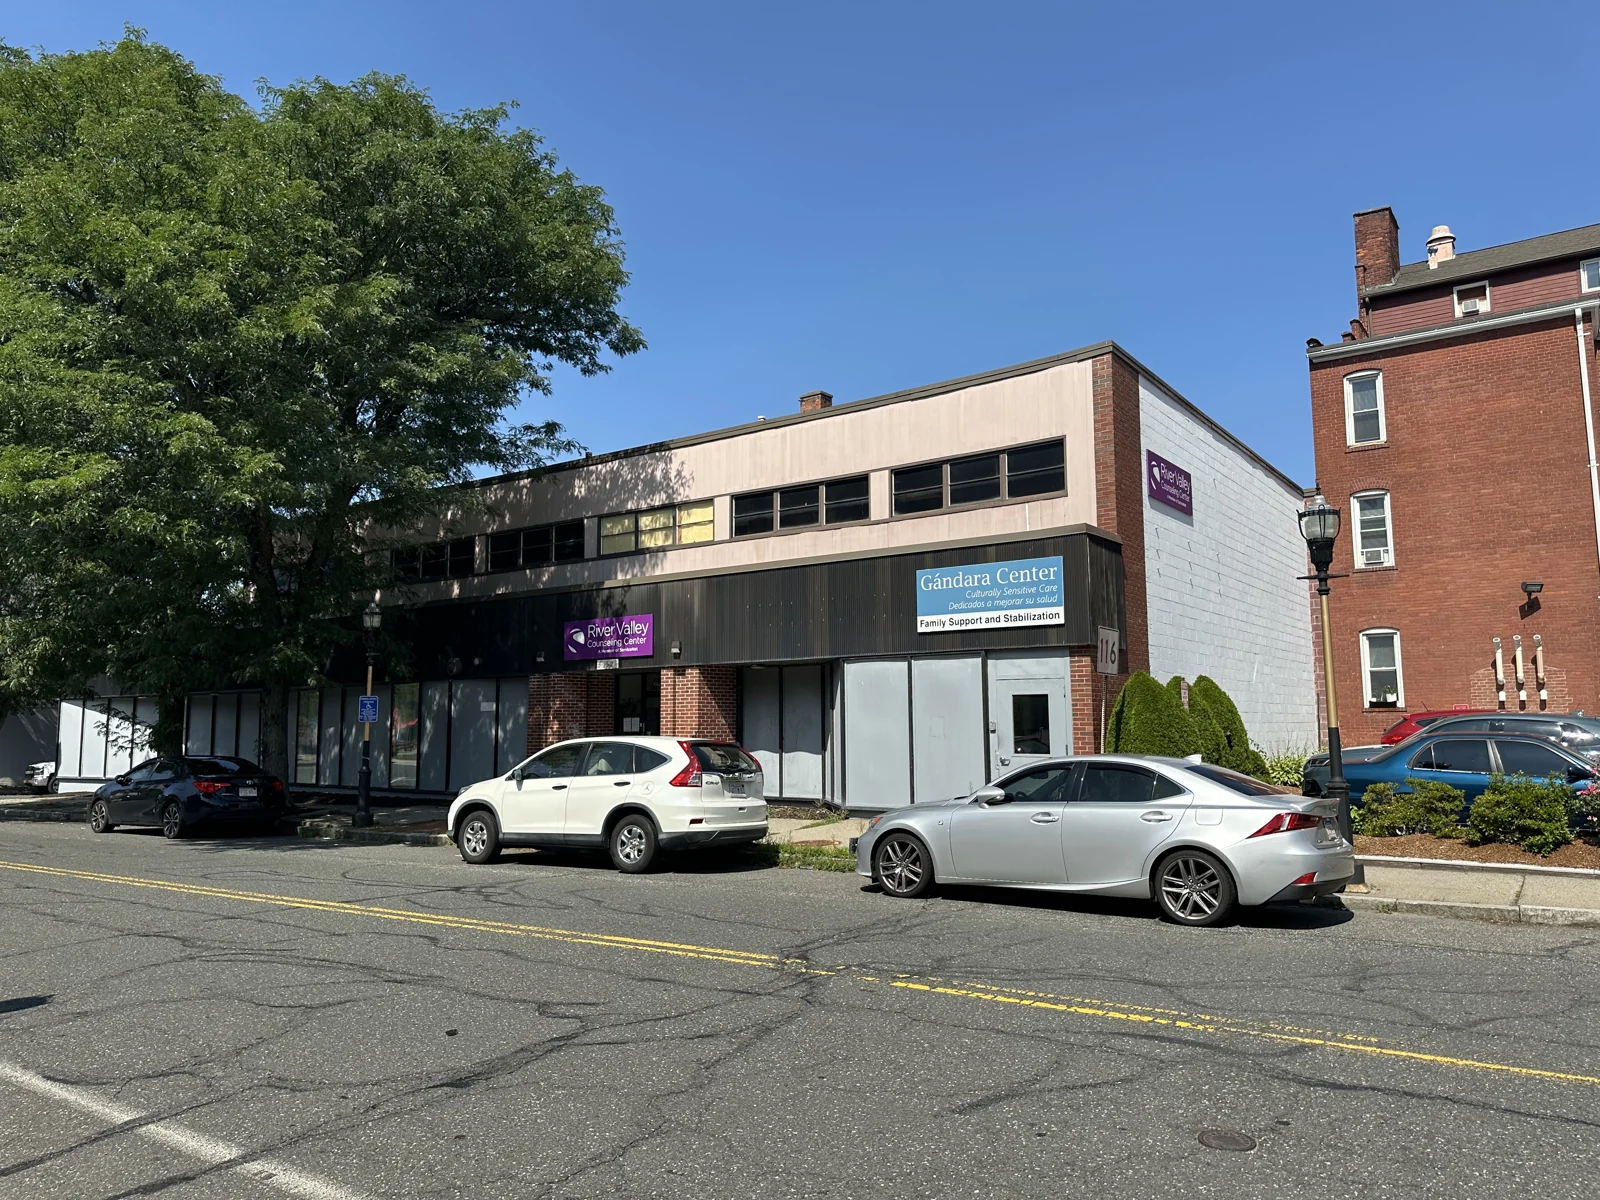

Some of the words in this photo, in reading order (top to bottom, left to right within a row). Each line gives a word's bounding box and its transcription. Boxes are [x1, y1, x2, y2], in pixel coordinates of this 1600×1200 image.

[920, 571, 991, 591] Gándara
[996, 566, 1058, 584] Center
[965, 588, 1002, 599] Culturally
[1003, 585, 1037, 596] Sensitive
[1038, 583, 1058, 593] Care
[948, 600, 985, 610] Dedicados
[986, 600, 992, 608] a
[993, 597, 1024, 609] mejorar
[1025, 597, 1035, 605] su
[1036, 594, 1058, 604] salud
[919, 618, 946, 629] Family
[948, 616, 983, 628] Support
[984, 614, 1001, 624] and
[1003, 611, 1060, 623] Stabilization
[588, 624, 616, 638] River
[616, 621, 649, 636] Valley
[587, 639, 622, 648] Counseling
[623, 637, 647, 645] Center
[1100, 637, 1117, 665] 116
